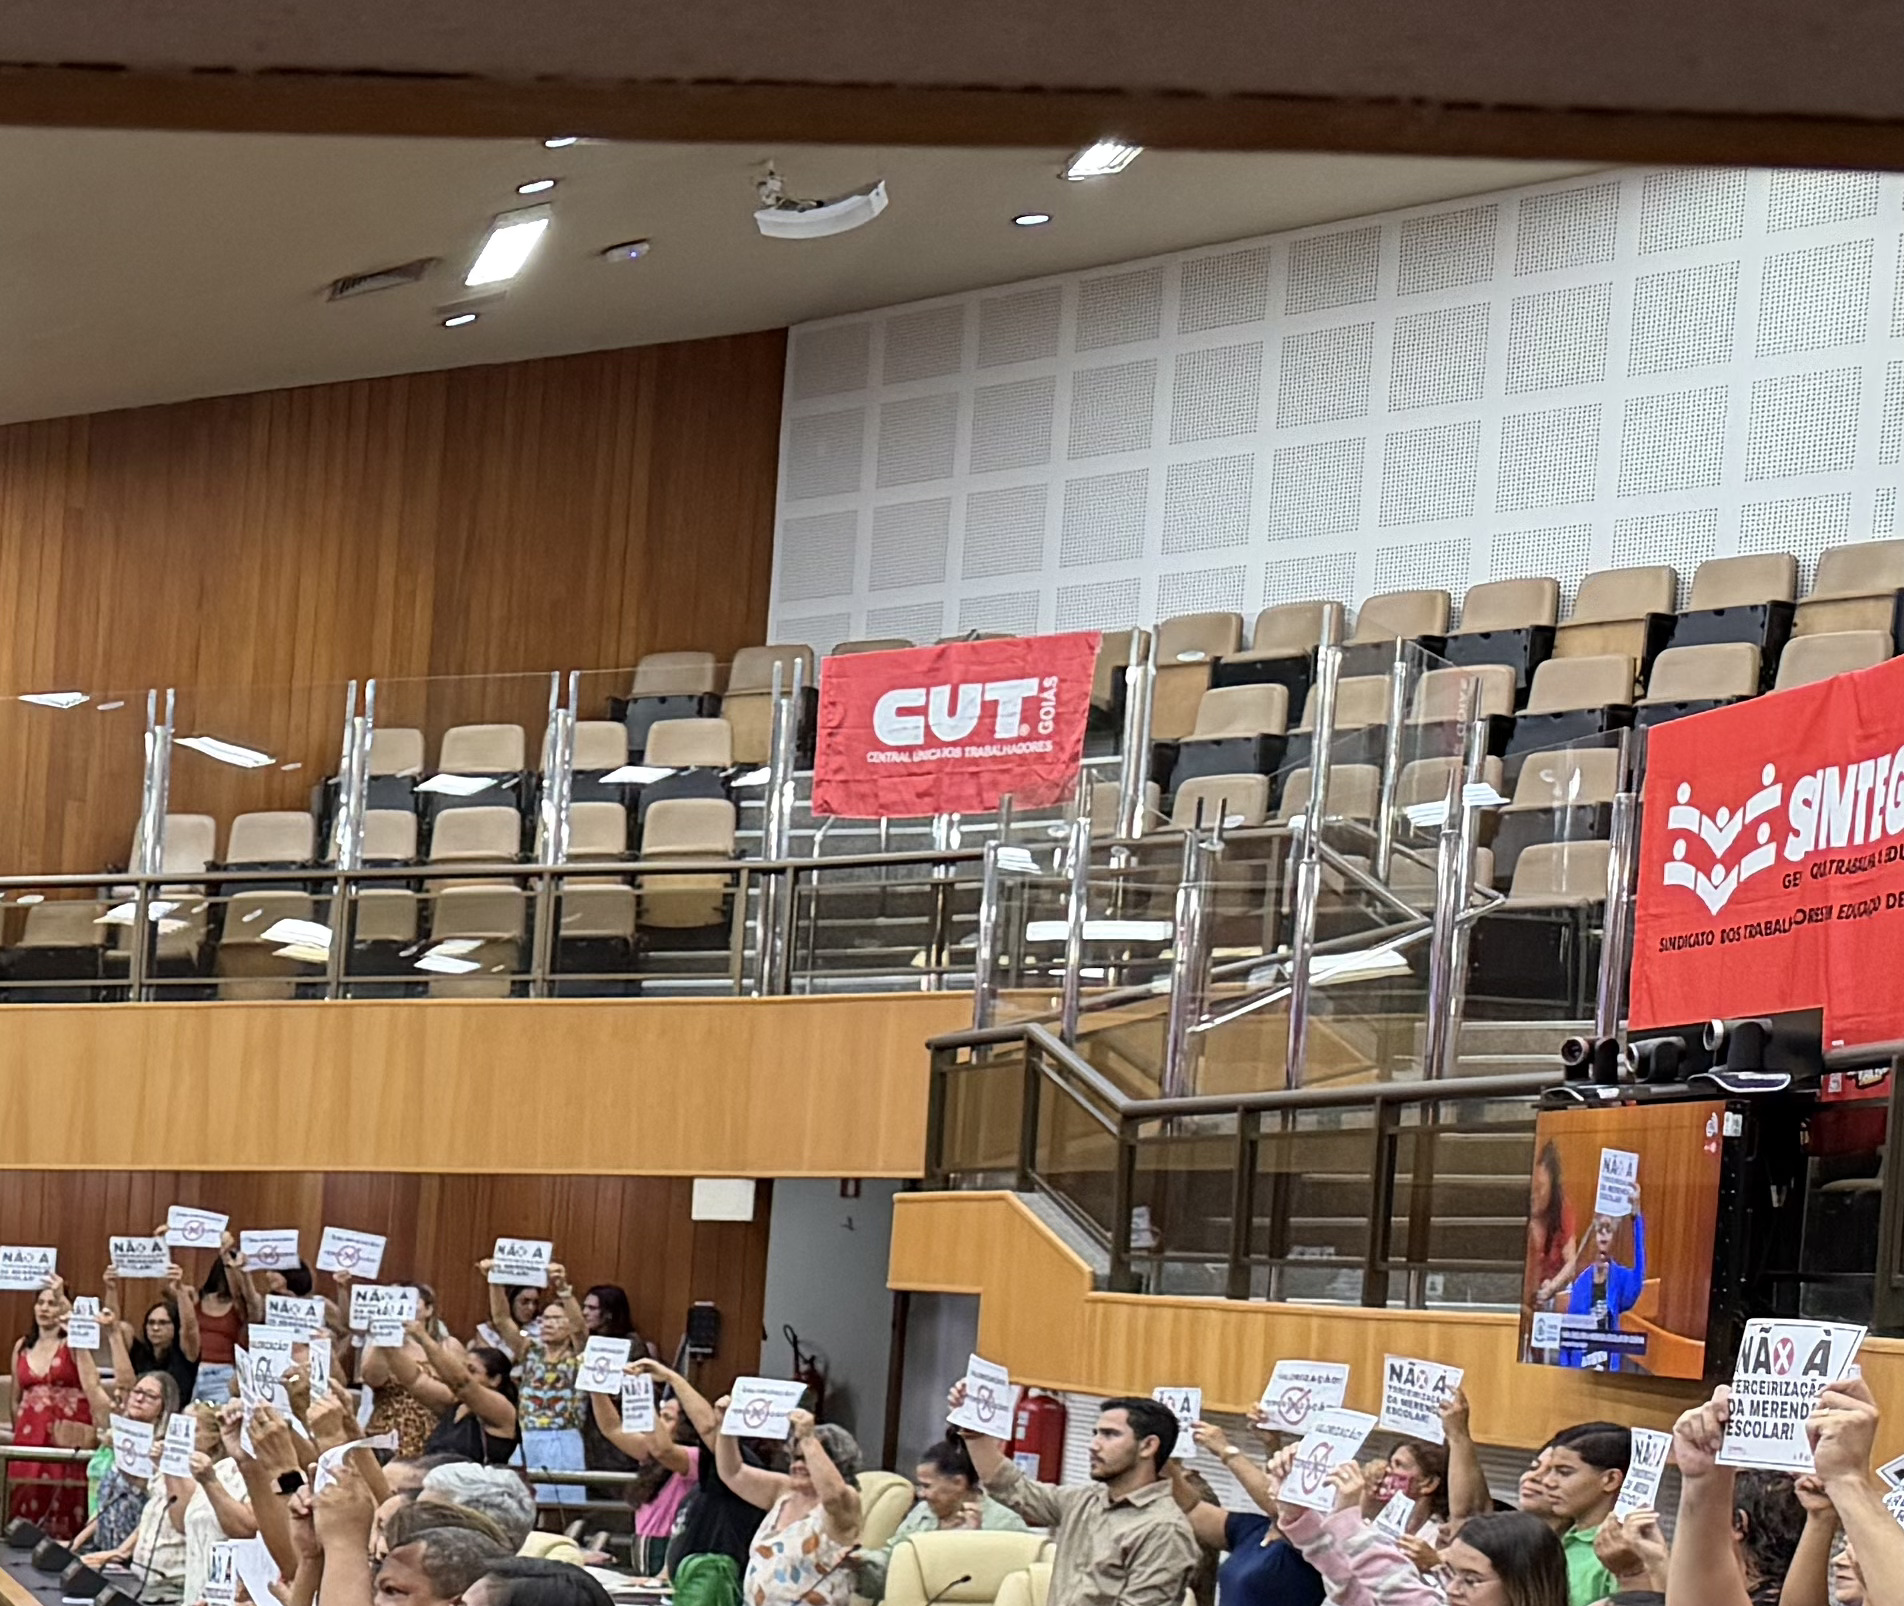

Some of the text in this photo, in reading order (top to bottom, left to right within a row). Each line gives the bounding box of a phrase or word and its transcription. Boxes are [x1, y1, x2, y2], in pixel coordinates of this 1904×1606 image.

[873, 677, 1040, 747] CUT
[866, 750, 912, 764] CENTRAL
[1802, 1329, 1833, 1377] À
[1728, 1398, 1817, 1420] DA MEREND
[1726, 1420, 1795, 1441] ESCOLAR!
